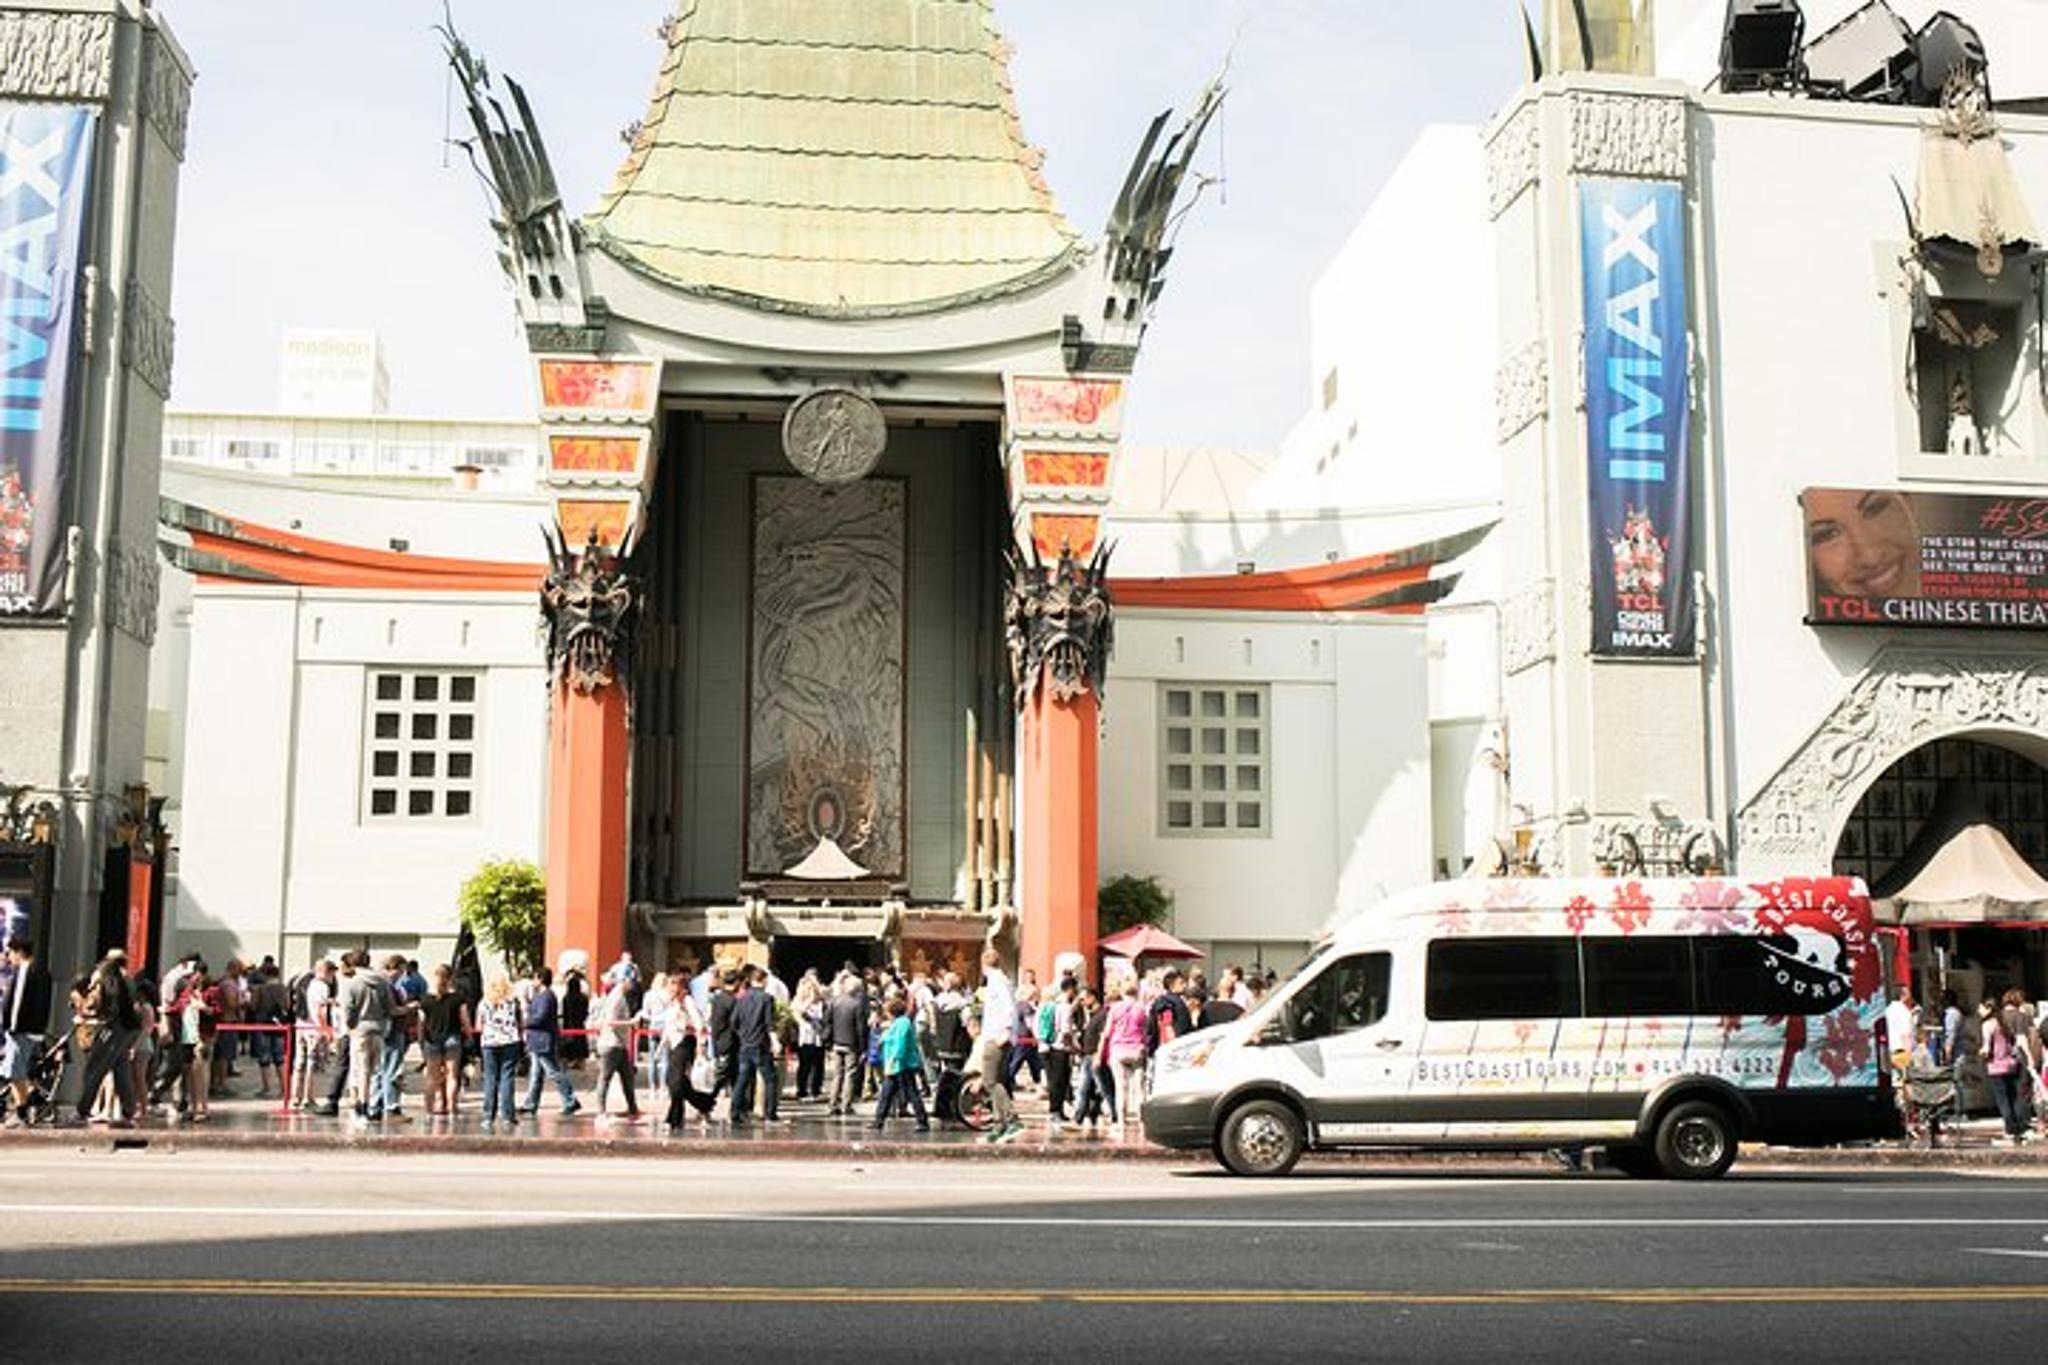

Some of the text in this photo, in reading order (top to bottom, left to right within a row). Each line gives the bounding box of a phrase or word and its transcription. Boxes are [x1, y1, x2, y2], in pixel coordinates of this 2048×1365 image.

[1602, 196, 1667, 482] IMAX
[1617, 594, 1665, 610] TCL
[1818, 595, 1880, 621] TCL
[1884, 599, 1982, 622] CHINESE
[1612, 630, 1674, 649] IMAX
[1766, 889, 1867, 954] BEST COAST
[1763, 954, 1841, 998] TOURS
